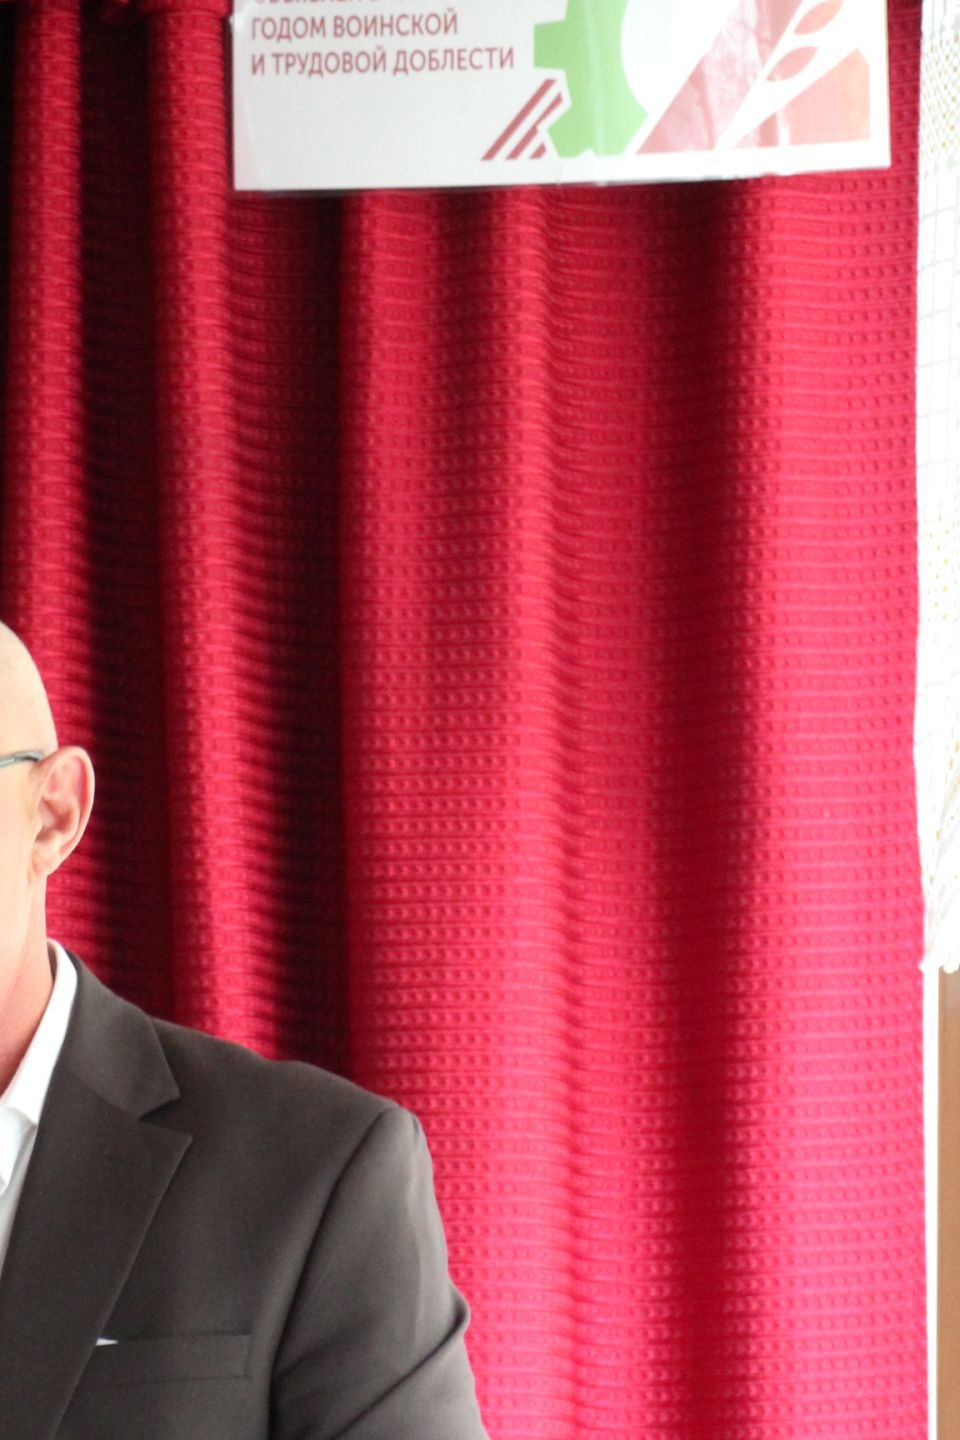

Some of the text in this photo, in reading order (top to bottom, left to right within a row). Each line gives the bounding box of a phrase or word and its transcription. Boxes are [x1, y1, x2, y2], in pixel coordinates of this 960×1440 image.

[251, 8, 458, 42] ГОДОМ ВОИНСКОЙ
[251, 47, 515, 77] И ТРУДОВОЙ ДОБЛЕСТИ
